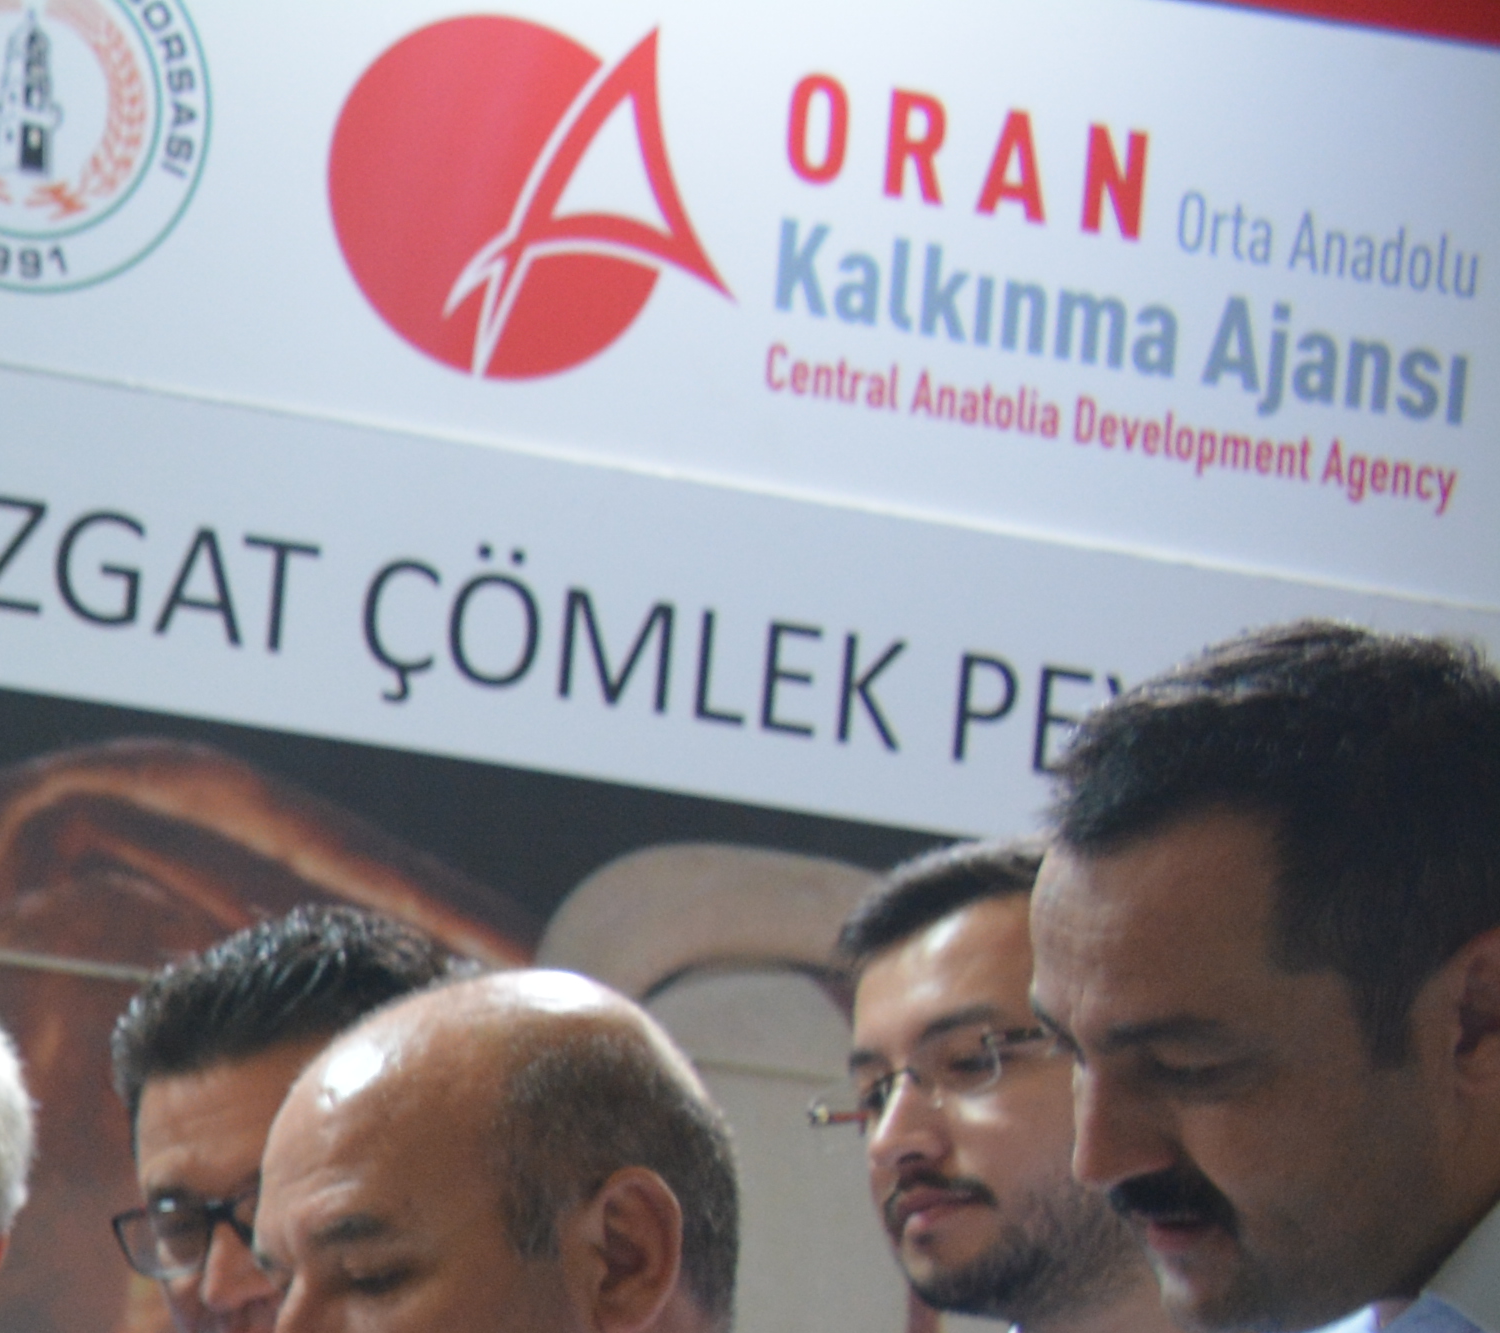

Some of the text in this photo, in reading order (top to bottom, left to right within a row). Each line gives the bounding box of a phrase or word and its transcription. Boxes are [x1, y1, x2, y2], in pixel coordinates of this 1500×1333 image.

[132, 0, 197, 180] ORSASI
[785, 71, 1480, 299] ORAN Orta Anadolu
[774, 217, 1469, 425] Kalkınma Ajansı
[764, 342, 1458, 516] Central Anatolia Development Agency
[362, 542, 908, 753] ÇÖMLEK
[951, 650, 1121, 775] PE
